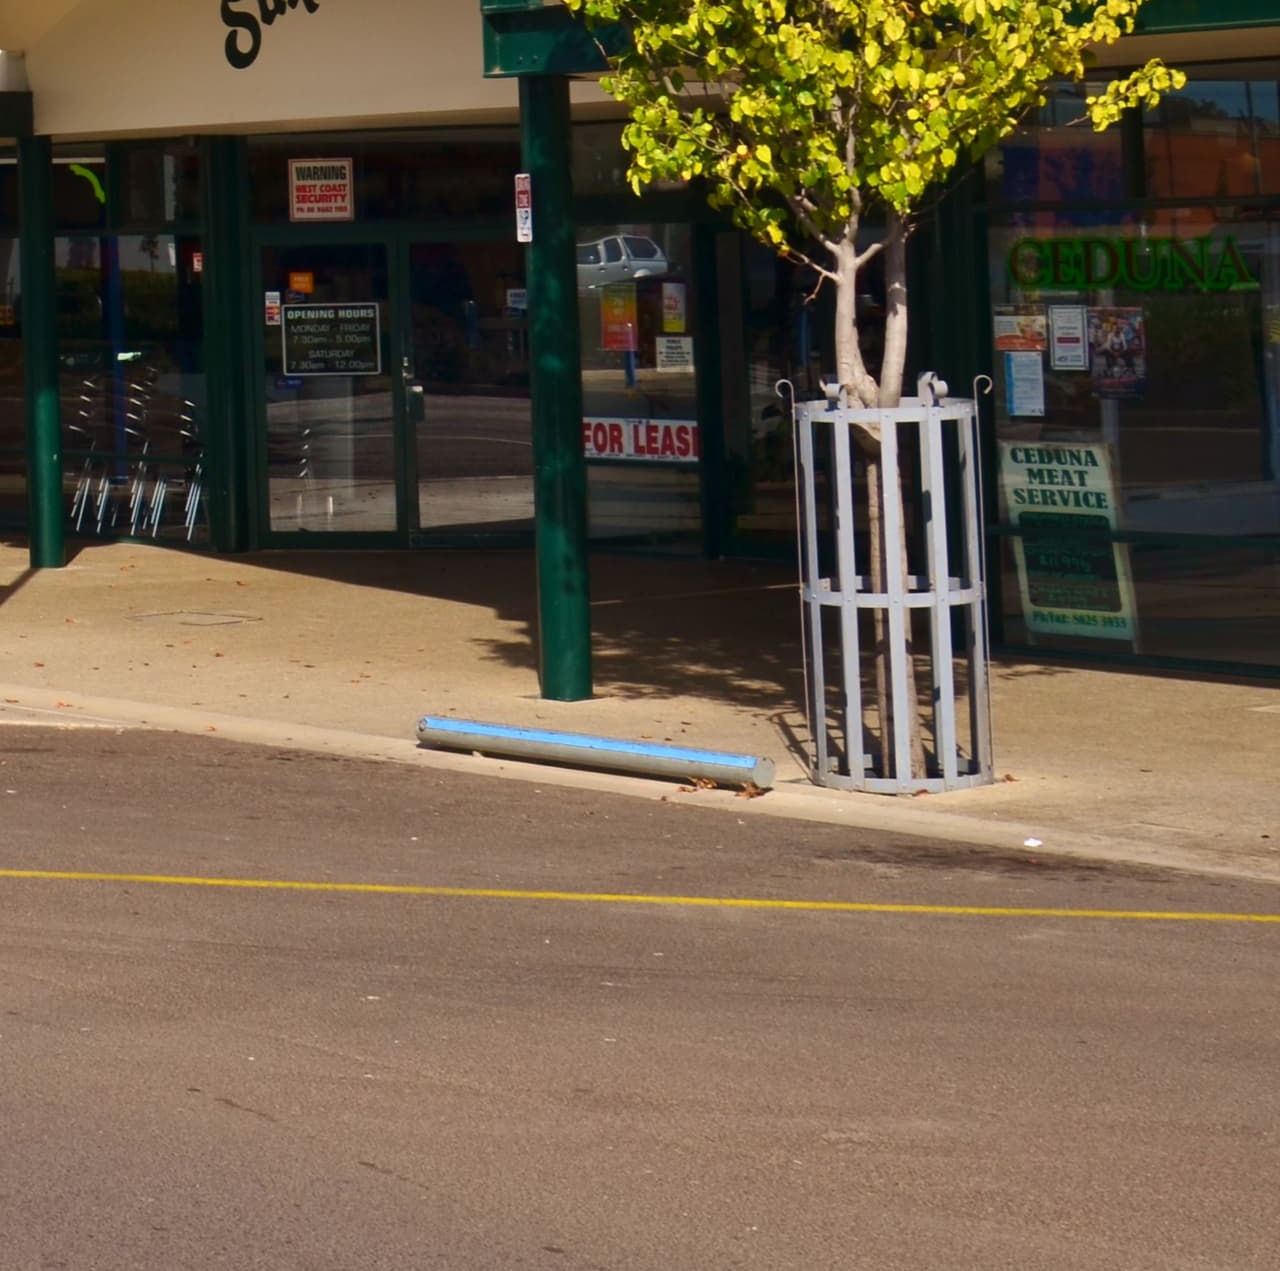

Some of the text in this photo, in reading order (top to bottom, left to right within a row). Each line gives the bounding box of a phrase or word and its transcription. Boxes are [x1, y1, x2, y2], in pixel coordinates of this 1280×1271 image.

[295, 165, 347, 181] WARNING
[295, 184, 347, 193] WEST COAST
[295, 194, 347, 204] SECURITY
[1009, 236, 1259, 290] CEDUNA
[287, 309, 375, 319] OPENING HOURS
[291, 324, 331, 332] MONDAY
[339, 323, 370, 332] FRIDAY
[308, 349, 355, 359] SATURDAY
[582, 423, 624, 454] FOR
[1010, 447, 1099, 467] CEDUNA
[1025, 468, 1089, 487] MEAT
[1013, 488, 1109, 509] SERVICE
